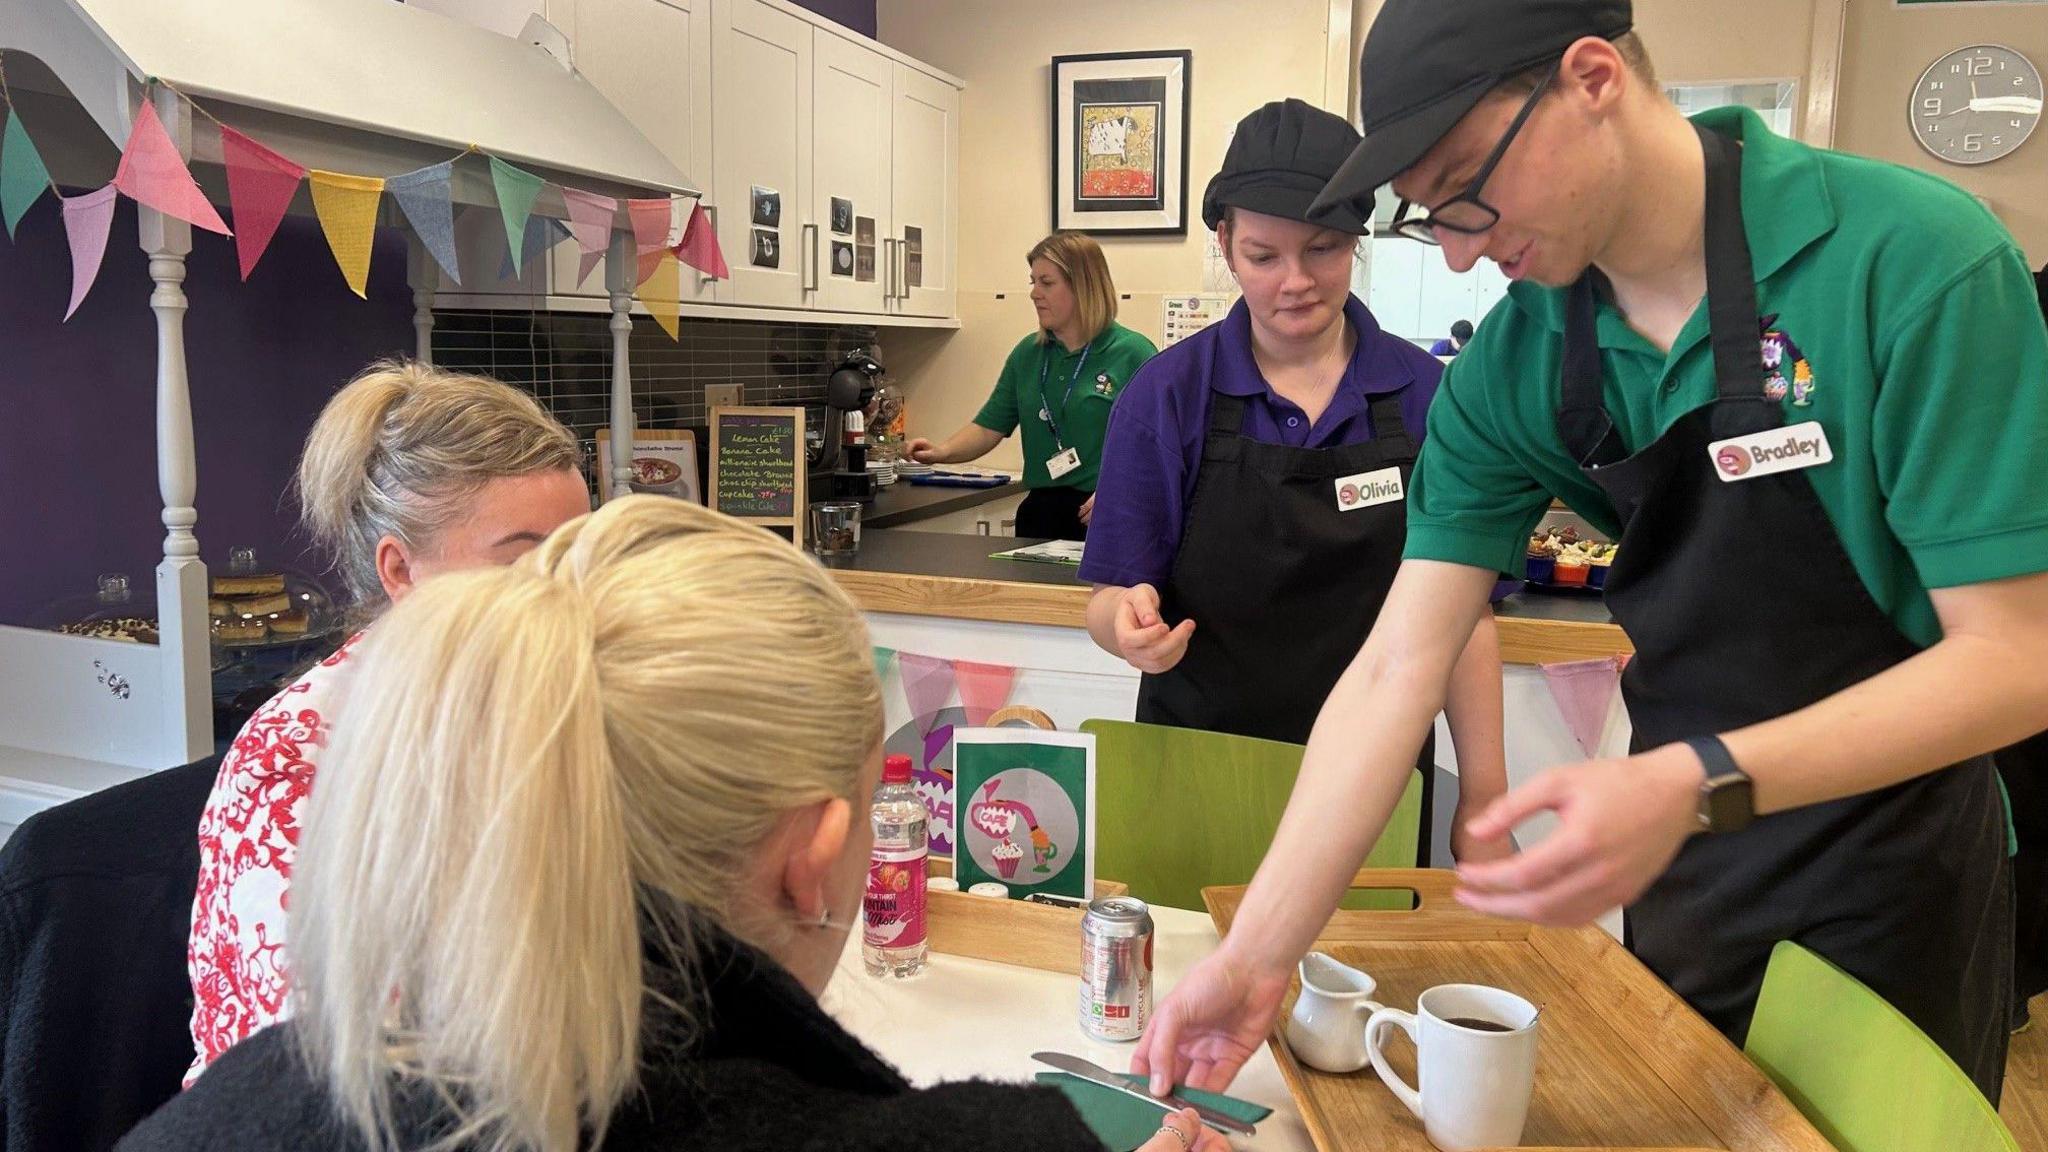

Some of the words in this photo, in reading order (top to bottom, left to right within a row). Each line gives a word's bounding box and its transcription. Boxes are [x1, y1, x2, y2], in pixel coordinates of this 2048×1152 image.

[1964, 56, 1992, 76] 12
[2013, 76, 2023, 86] 2
[1923, 98, 1941, 117] 9
[2010, 119, 2020, 128] 4
[1964, 133, 1983, 152] 6
[1992, 135, 2001, 145] 5
[760, 433, 780, 443] Cake
[755, 445, 782, 455] Cake
[1750, 437, 1820, 463] Bradley
[1359, 480, 1400, 500] Olivia
[981, 812, 1008, 827] CAFE
